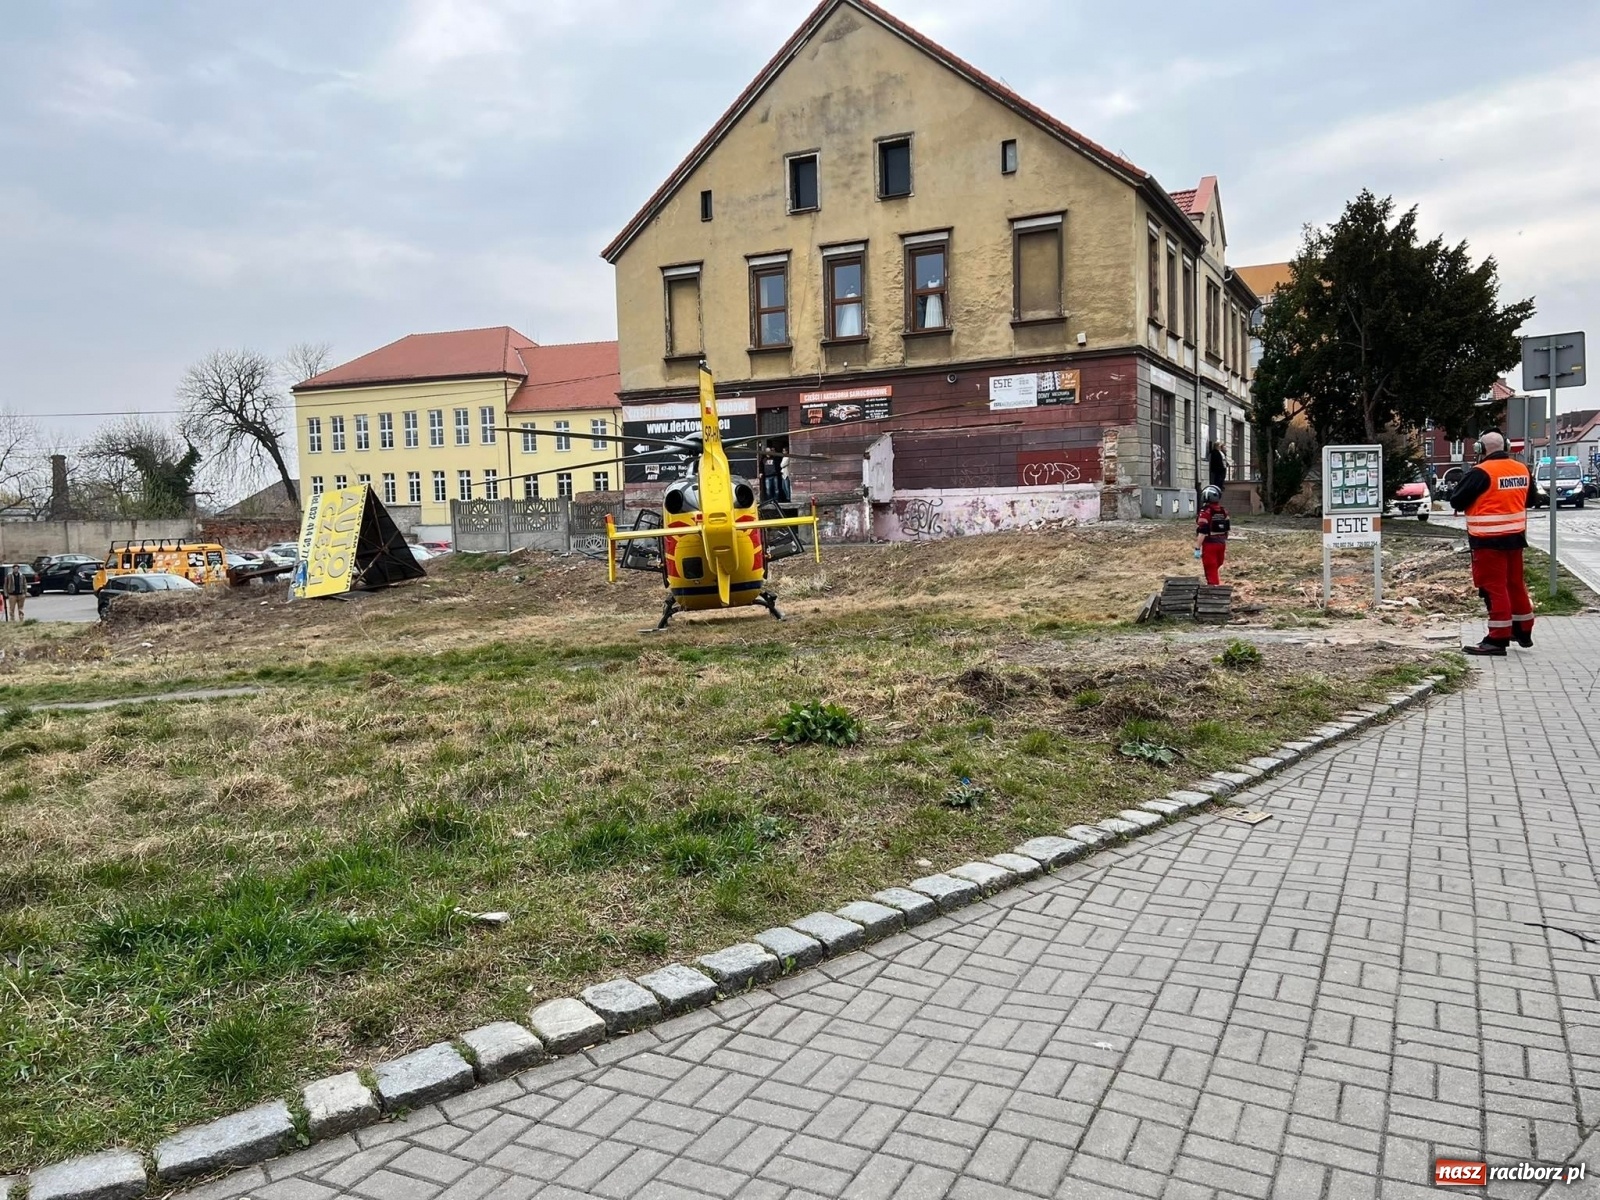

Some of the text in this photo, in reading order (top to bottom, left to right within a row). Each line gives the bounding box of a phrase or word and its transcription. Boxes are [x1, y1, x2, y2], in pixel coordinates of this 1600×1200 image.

[993, 378, 1012, 388] ESTE
[849, 388, 888, 398] SAMOCHODOWE
[646, 418, 731, 435] www.derkoweu
[308, 507, 318, 520] 032
[306, 522, 315, 538] 414
[1336, 517, 1369, 533] ESTE
[327, 491, 360, 579] AUTO
